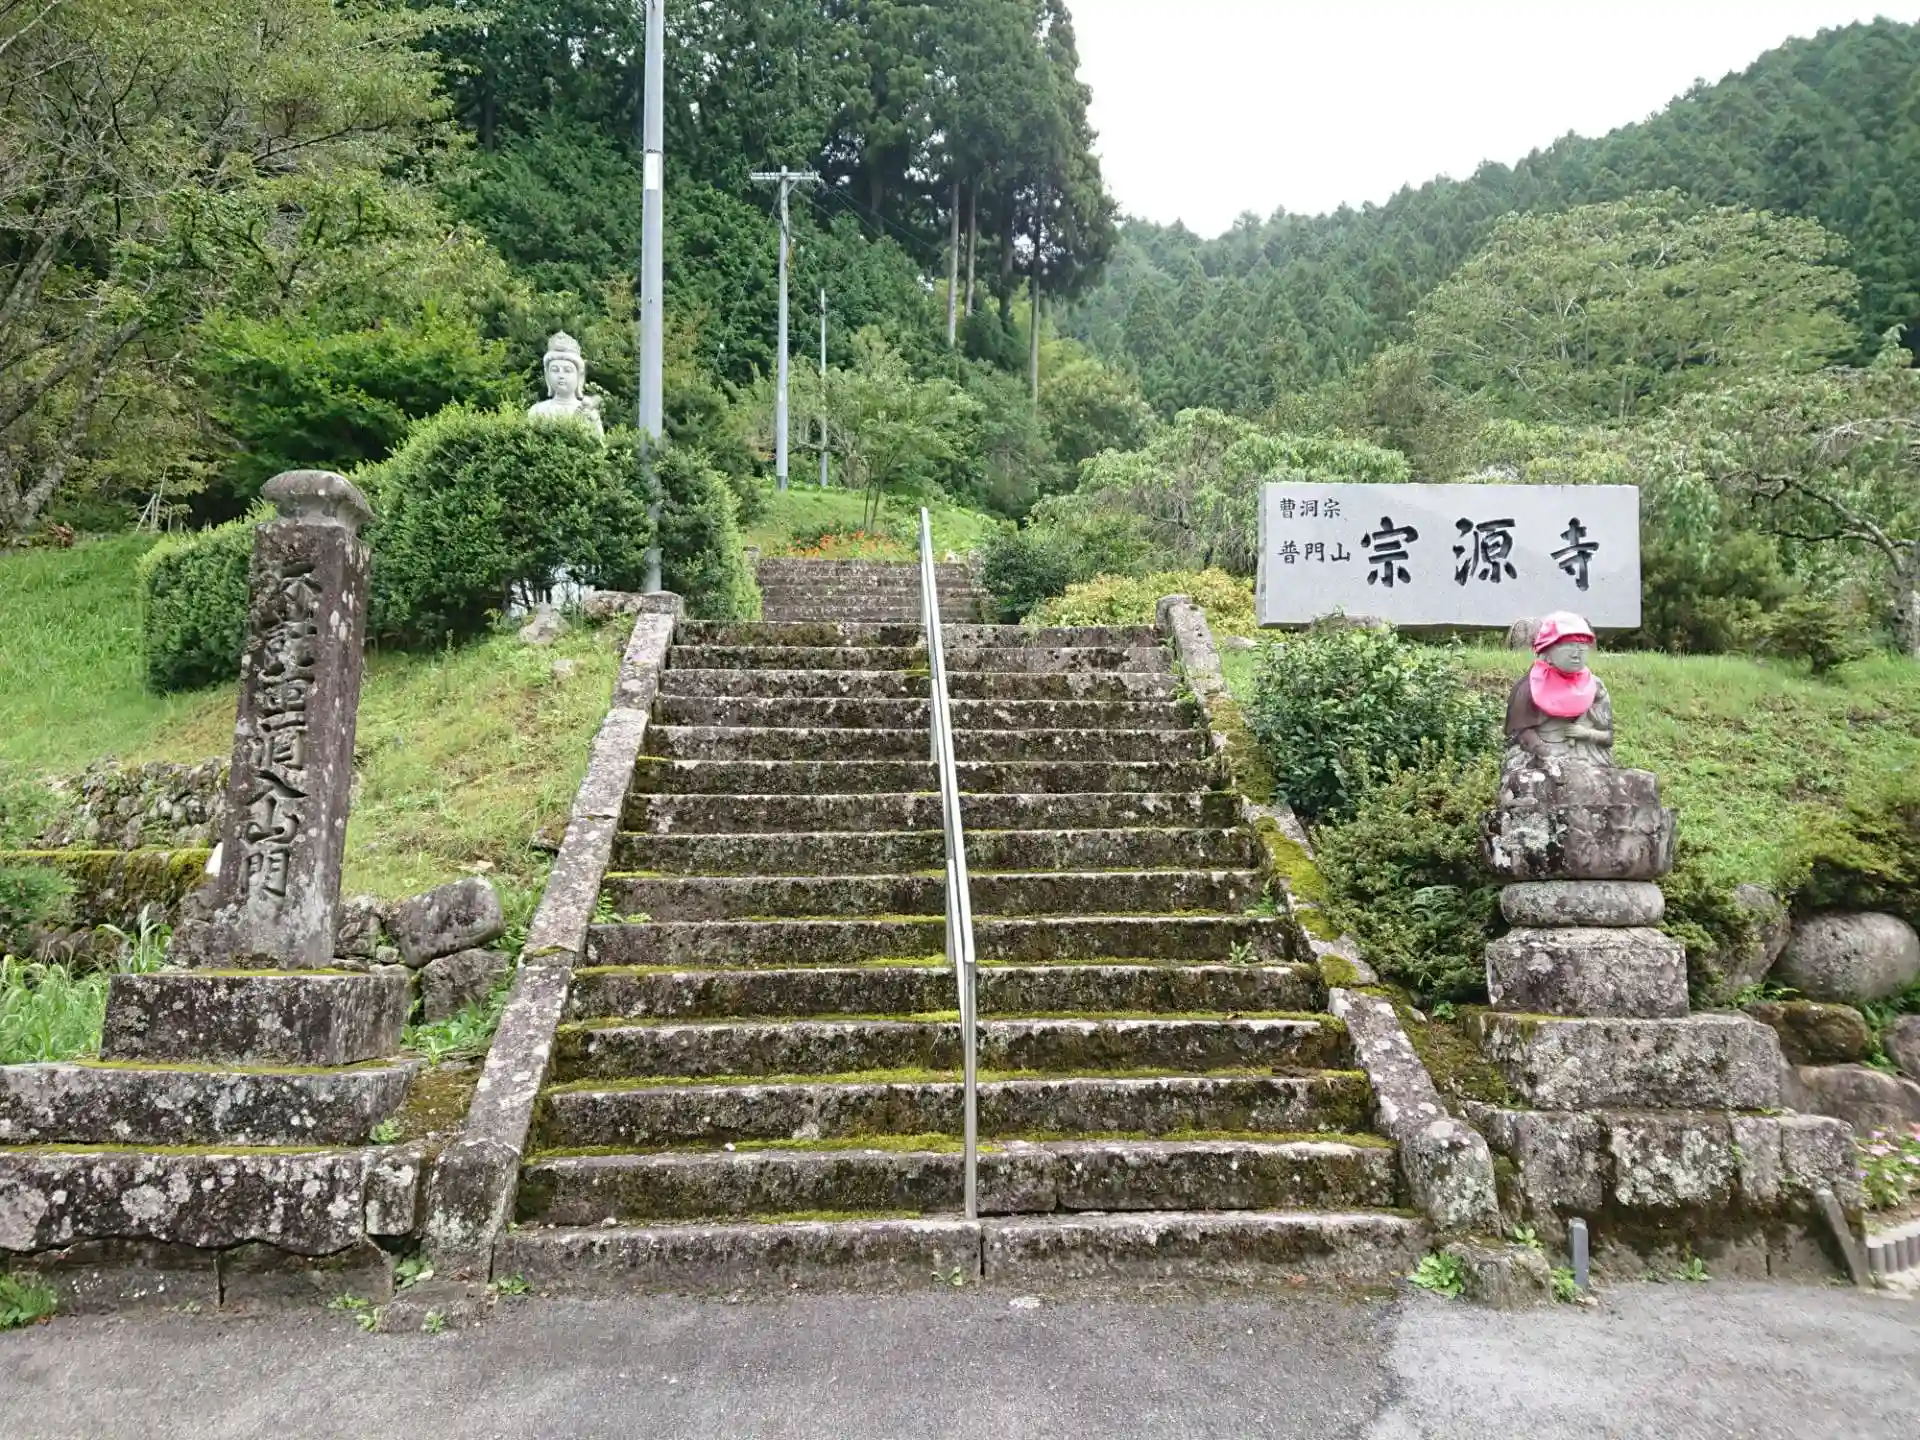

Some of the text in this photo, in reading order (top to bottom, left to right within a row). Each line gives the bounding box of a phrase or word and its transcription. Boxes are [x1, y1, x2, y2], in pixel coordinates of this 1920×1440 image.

[1280, 498, 1340, 519] 曹洞宗
[1278, 540, 1351, 564] 普門山
[1360, 516, 1599, 591] 宗源寺
